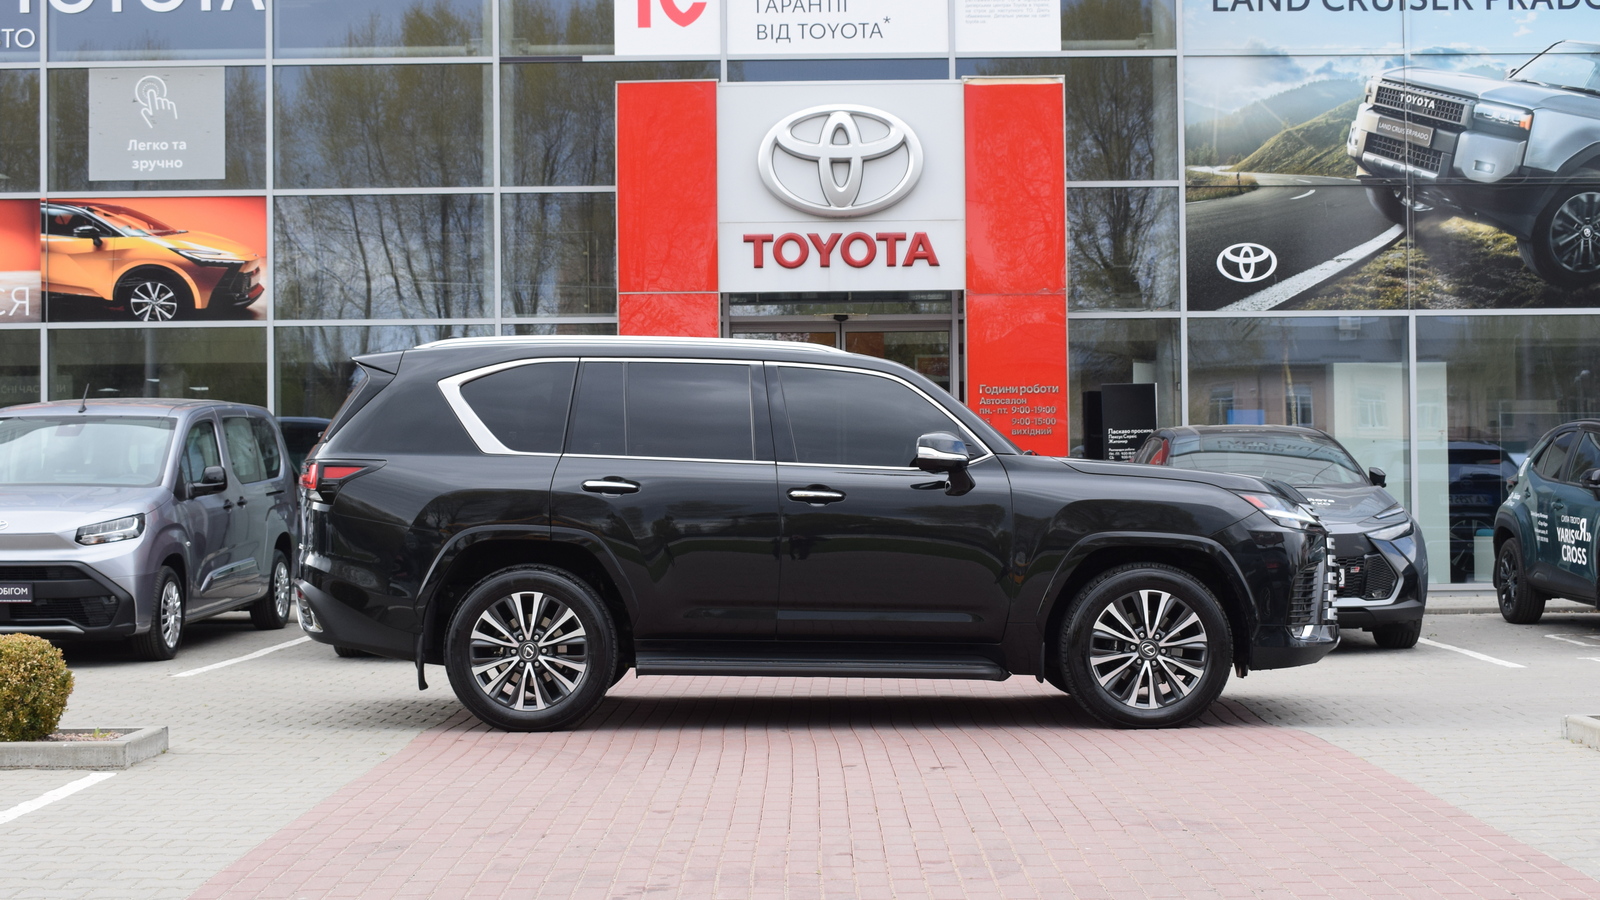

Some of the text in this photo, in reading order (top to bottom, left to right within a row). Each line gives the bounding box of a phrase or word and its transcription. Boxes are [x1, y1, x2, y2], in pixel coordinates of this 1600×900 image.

[756, 24, 791, 43] ВІД
[1400, 93, 1435, 110] TOYOTA
[127, 139, 187, 151] Легко та
[132, 159, 183, 172] зручно
[743, 231, 940, 269] TOYOTA
[979, 384, 1059, 395] Години роботи
[979, 397, 1027, 405] Автосалон
[1011, 427, 1052, 436] вихідний
[1556, 527, 1575, 545] YARIS
[1561, 544, 1587, 565] CROSS
